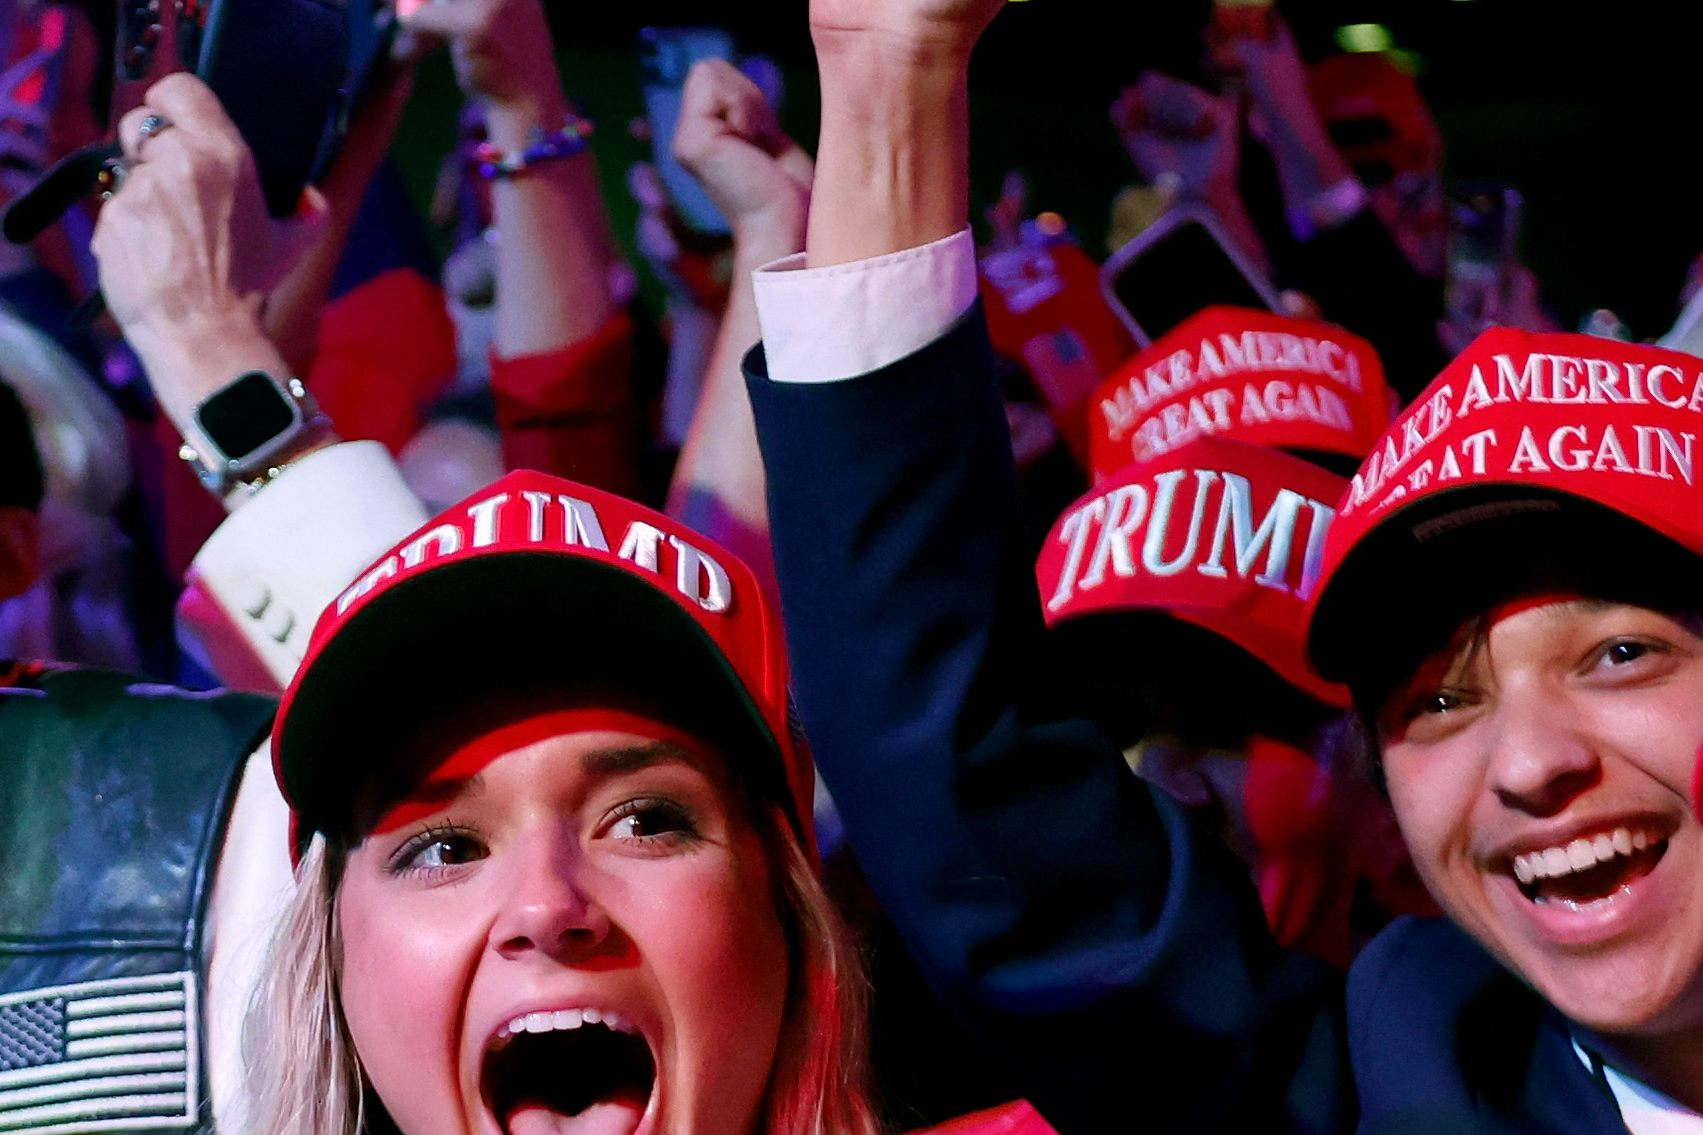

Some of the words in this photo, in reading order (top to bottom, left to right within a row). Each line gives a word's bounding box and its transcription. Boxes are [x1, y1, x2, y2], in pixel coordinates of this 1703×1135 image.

[1100, 349, 1197, 441] MAKE
[1240, 380, 1354, 433] AGAIN
[1340, 384, 1454, 517] MAKE
[1369, 429, 1499, 515] EAT
[1507, 423, 1697, 487] AGAIN
